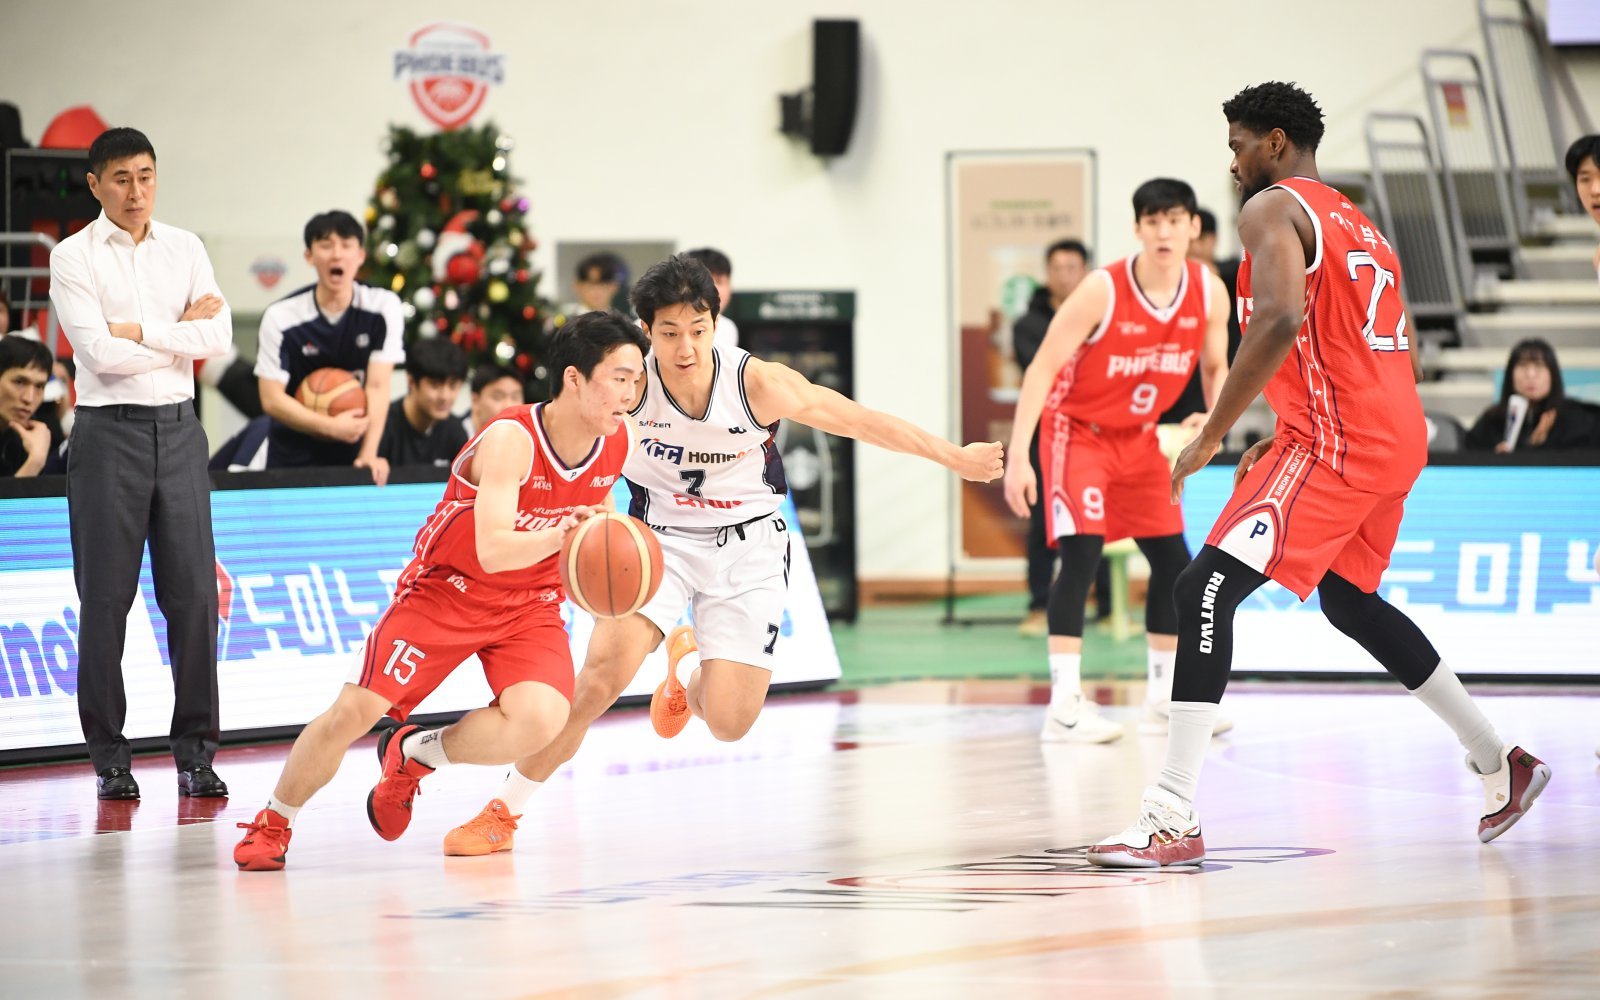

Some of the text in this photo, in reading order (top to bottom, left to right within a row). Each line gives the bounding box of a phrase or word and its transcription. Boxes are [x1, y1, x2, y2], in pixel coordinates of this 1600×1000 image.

[1129, 383, 1158, 415] 9
[678, 468, 706, 498] 7
[1081, 486, 1105, 520] 9
[1249, 520, 1268, 539] P
[1199, 571, 1225, 654] RUNTWO
[763, 622, 779, 656] 7
[382, 639, 426, 685] 15
